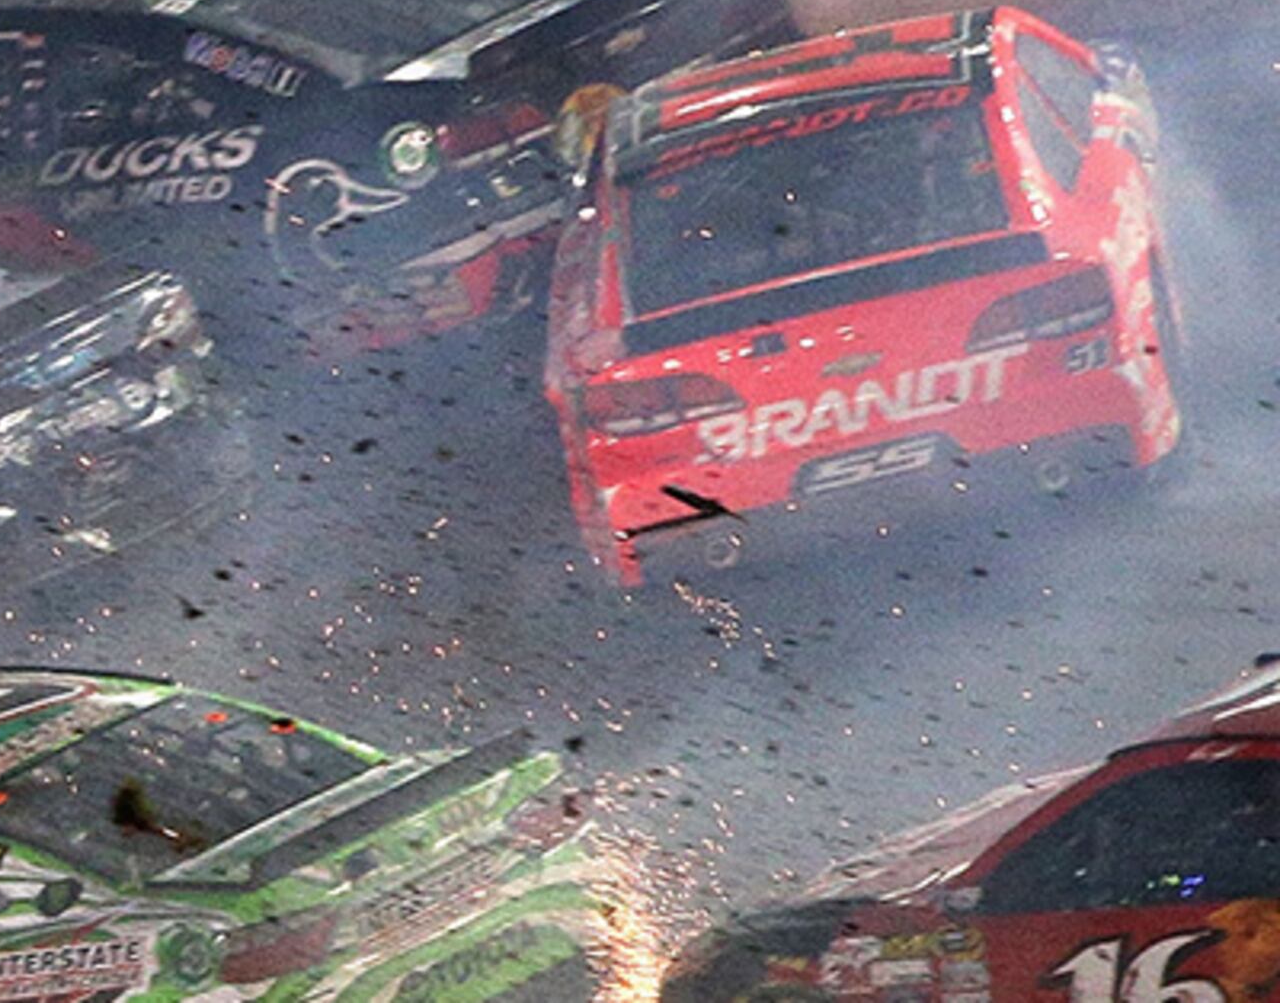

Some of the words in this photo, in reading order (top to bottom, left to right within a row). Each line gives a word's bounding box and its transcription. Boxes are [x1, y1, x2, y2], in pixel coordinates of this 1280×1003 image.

[38, 125, 266, 186] DUCKS
[693, 341, 1030, 465] BRANDT
[803, 435, 937, 495] SS
[1052, 928, 1230, 1003] 16
